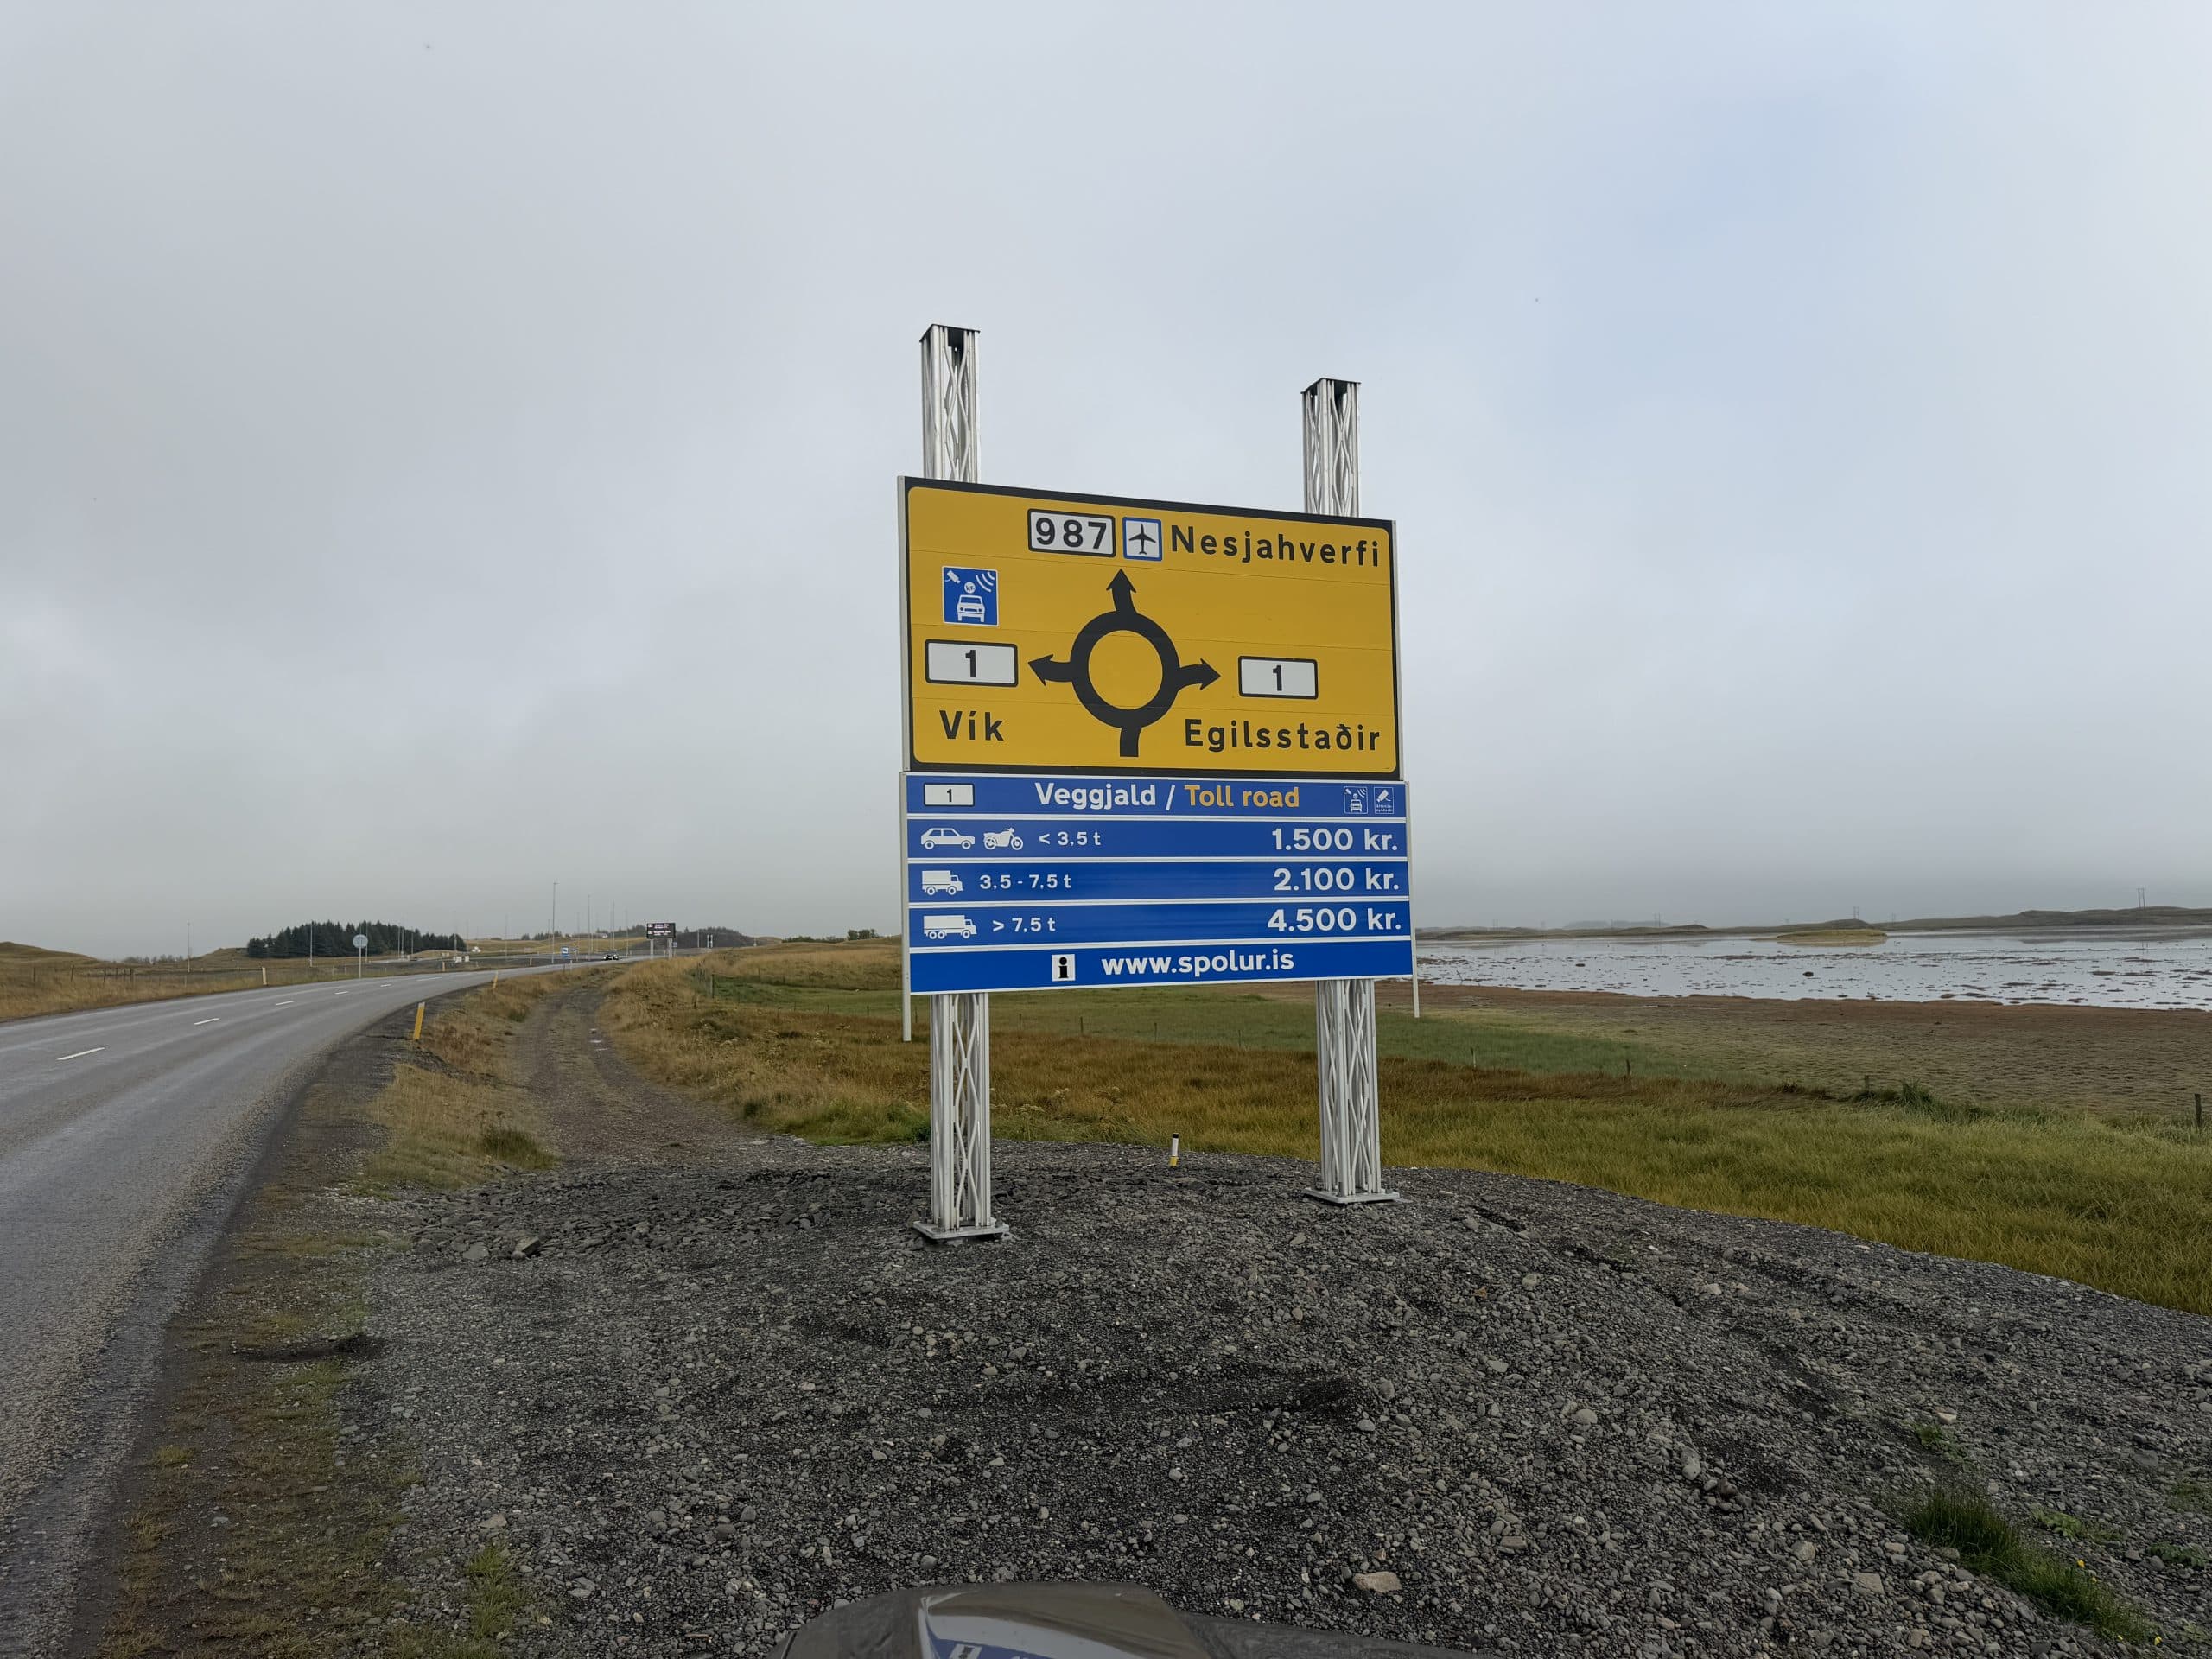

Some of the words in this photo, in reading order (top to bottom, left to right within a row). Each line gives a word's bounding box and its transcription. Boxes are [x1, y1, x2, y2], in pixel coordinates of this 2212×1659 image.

[1036, 518, 1108, 550] 987
[1171, 524, 1380, 568] Nesjahverfi
[965, 649, 977, 678] 1
[1273, 664, 1283, 692] 1
[939, 709, 1005, 741] Vík
[1185, 718, 1381, 753] Egilsstaðir
[947, 788, 953, 803] 1
[1035, 782, 1156, 810] Veggjald
[1166, 785, 1176, 810] /
[1185, 785, 1234, 807] Toll
[1243, 786, 1300, 808] road
[1057, 831, 1088, 847] 3,5
[1093, 831, 1102, 846] t
[1272, 828, 1353, 851] 1.500
[1364, 829, 1398, 851] kr.
[980, 874, 1012, 890] 3,5
[1029, 874, 1058, 890] 7,5
[1064, 874, 1071, 888] t
[1274, 868, 1355, 891] 2.100
[1365, 868, 1400, 890] kr.
[1012, 917, 1042, 933] 7,5
[1047, 917, 1056, 931] t
[1268, 907, 1357, 931] 4.500
[1367, 907, 1402, 931] kr.
[1102, 948, 1294, 977] www.spolur.is
